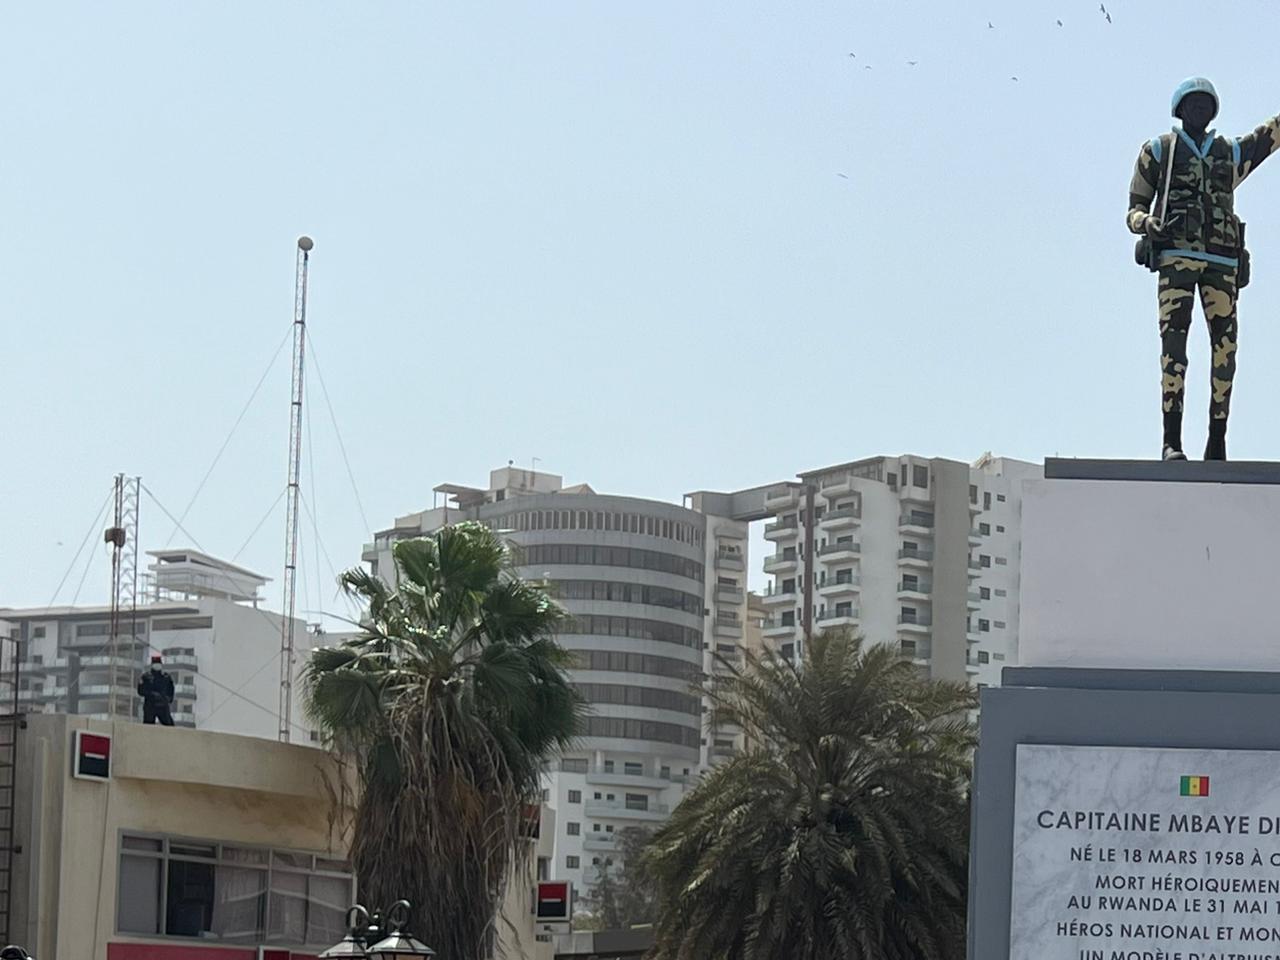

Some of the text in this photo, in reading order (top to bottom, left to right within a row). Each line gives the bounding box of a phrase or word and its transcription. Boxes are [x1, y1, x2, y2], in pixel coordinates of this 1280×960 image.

[1036, 809, 1161, 833] CAPITAINE
[1167, 813, 1250, 835] MBAYE
[1070, 842, 1093, 862] NÉ
[1098, 847, 1116, 863] LE
[1123, 848, 1143, 864] 18
[1147, 848, 1198, 865] MARS
[1204, 850, 1245, 867] 1958
[1249, 847, 1264, 867] À
[1094, 874, 1146, 891] MORT
[1066, 895, 1092, 911] AU
[1098, 895, 1178, 913] RWANDA
[1183, 897, 1202, 913] LE
[1206, 898, 1225, 915] 31
[1232, 899, 1268, 915] MAI
[1056, 917, 1114, 938] HÉROS
[1119, 923, 1211, 941] NATIONAL
[1216, 926, 1235, 941] ET
